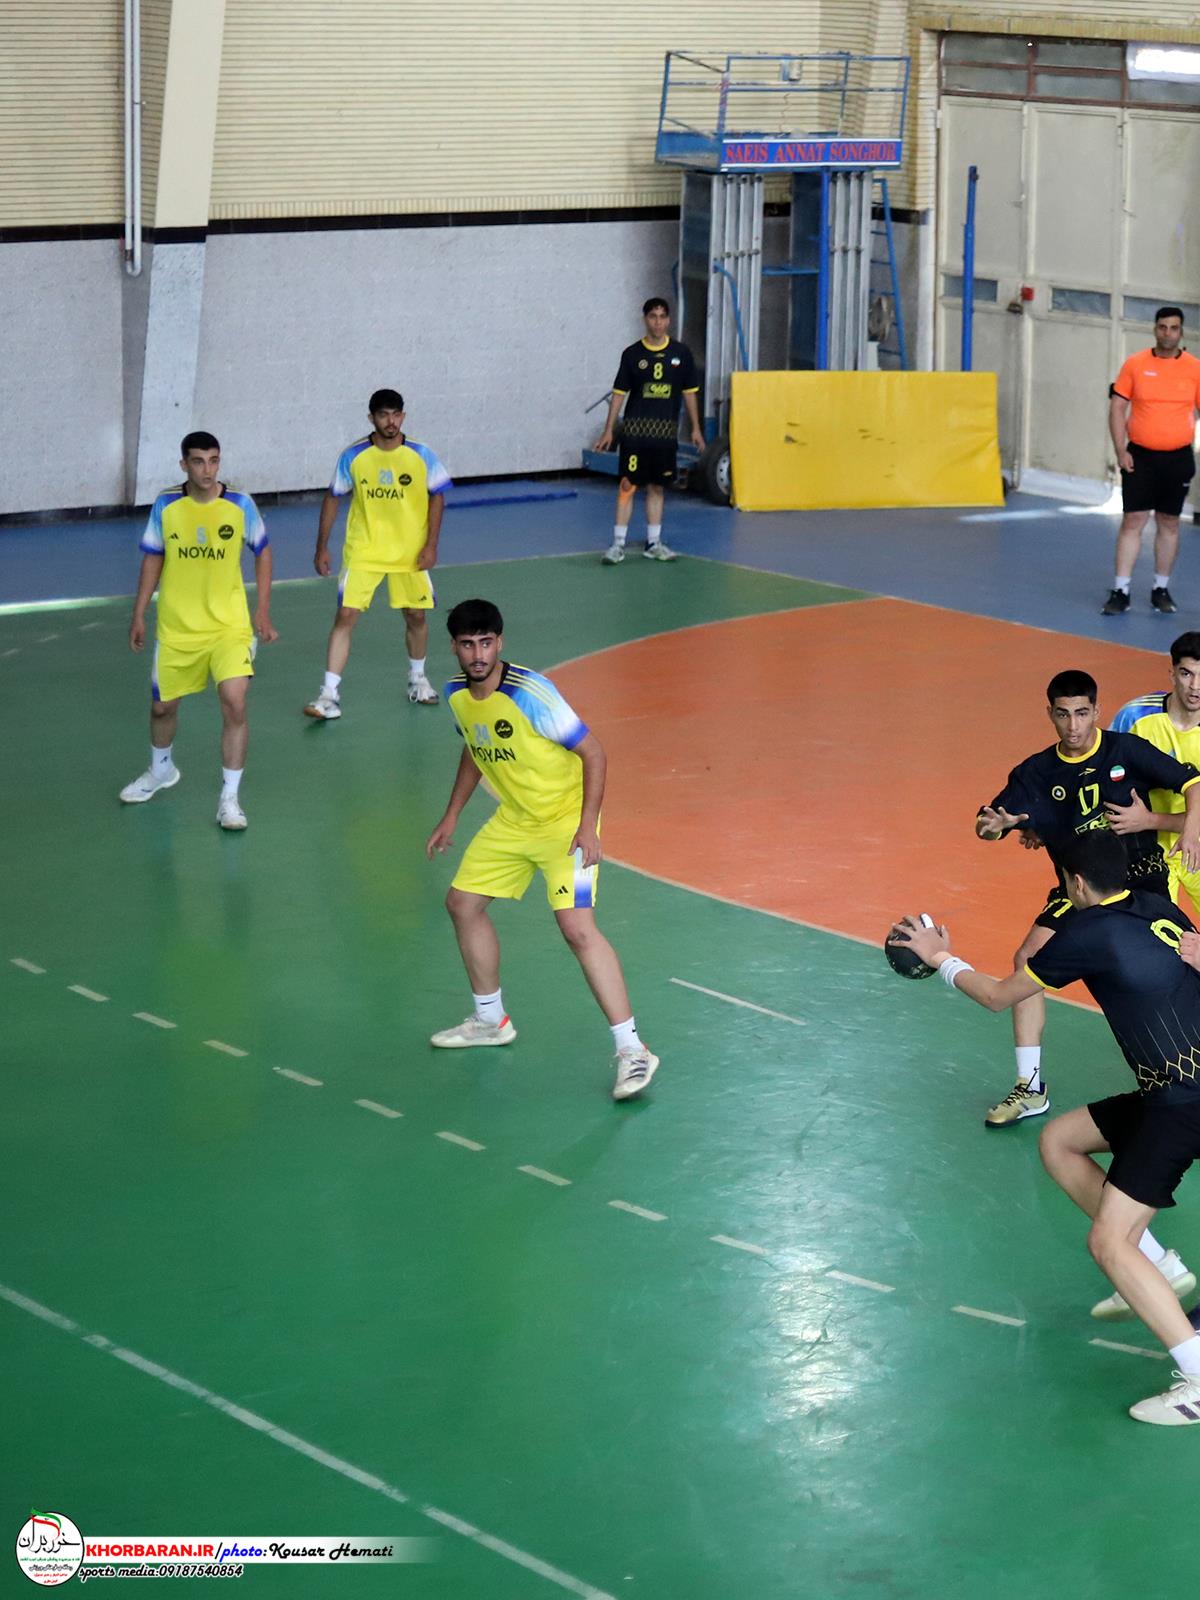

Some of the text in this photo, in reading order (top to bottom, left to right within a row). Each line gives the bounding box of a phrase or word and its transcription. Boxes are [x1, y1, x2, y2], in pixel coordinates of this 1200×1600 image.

[653, 362, 663, 379] 8
[628, 454, 638, 472] 8
[366, 487, 405, 500] NOYAN
[178, 546, 225, 560] NOYAN
[1078, 783, 1099, 816] 17
